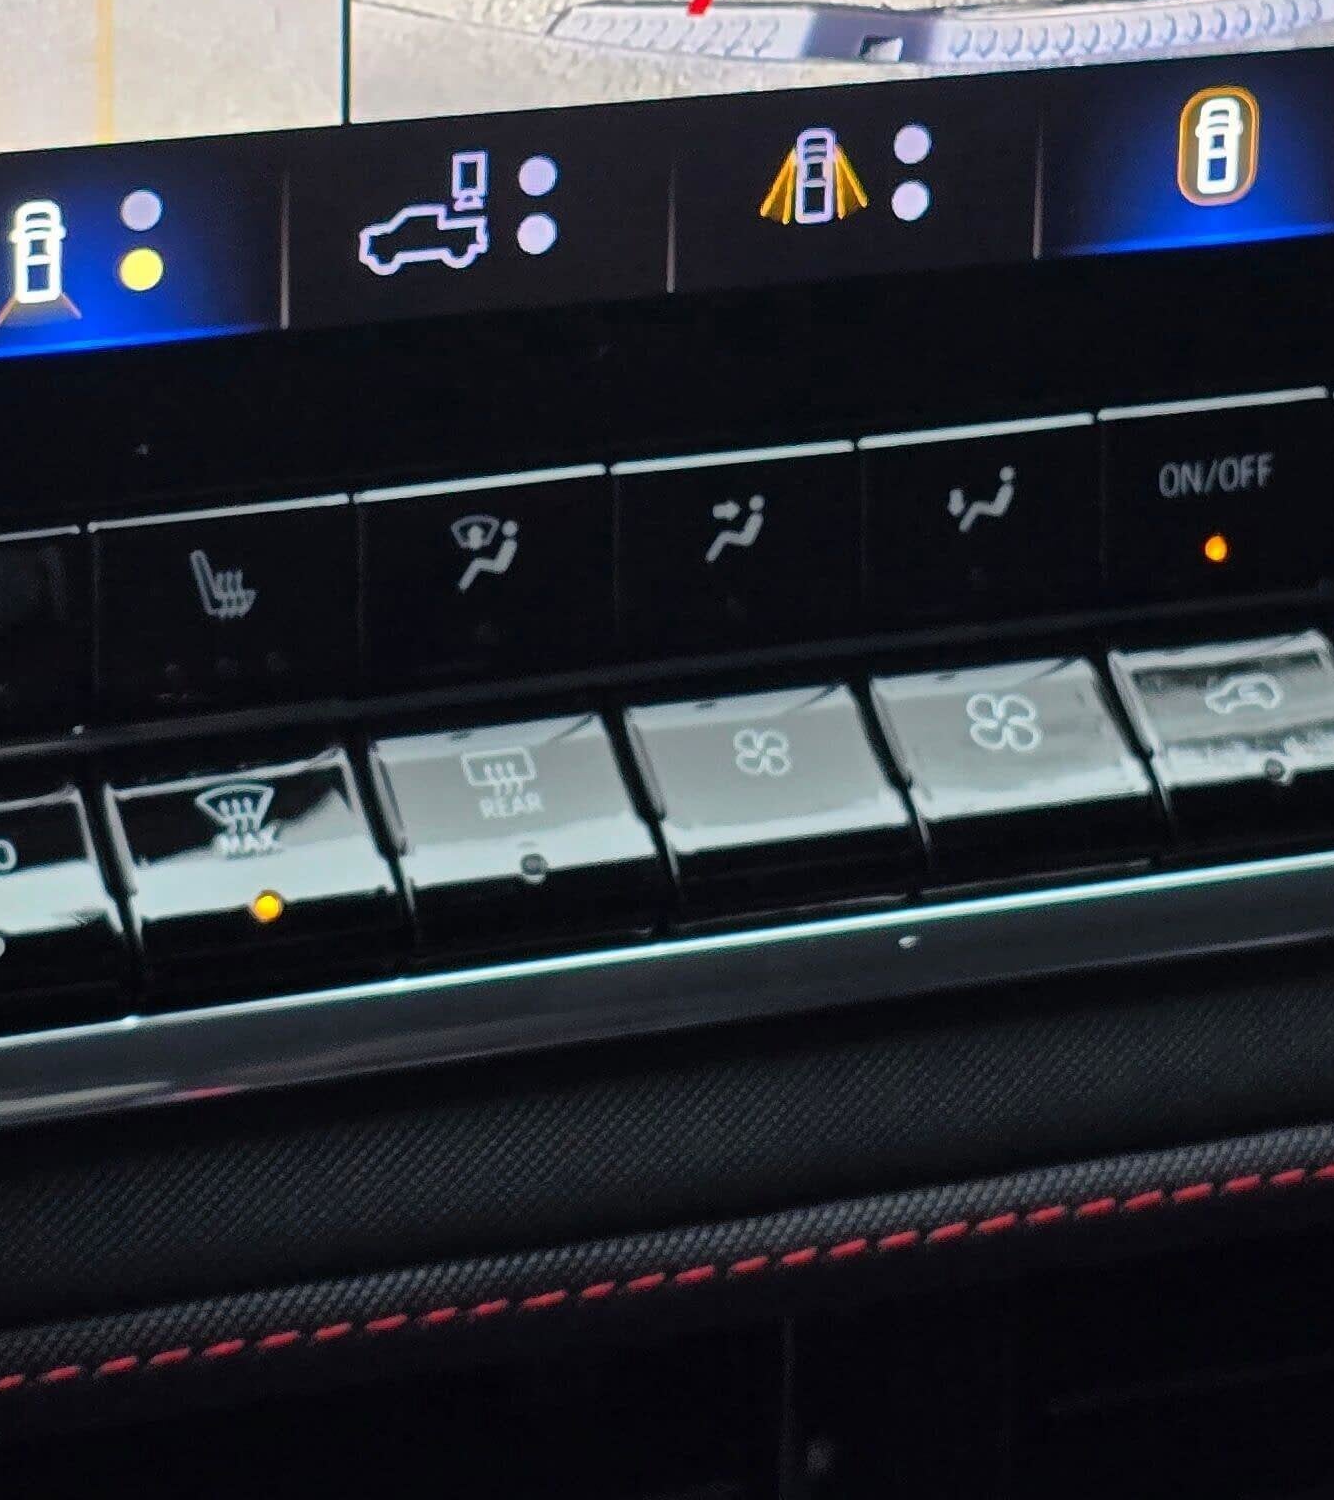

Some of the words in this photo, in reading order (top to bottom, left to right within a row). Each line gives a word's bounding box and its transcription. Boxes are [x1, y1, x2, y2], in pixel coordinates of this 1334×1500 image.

[1158, 451, 1274, 498] ON/OFF
[478, 791, 545, 820] REAR
[216, 823, 281, 855] MAX
